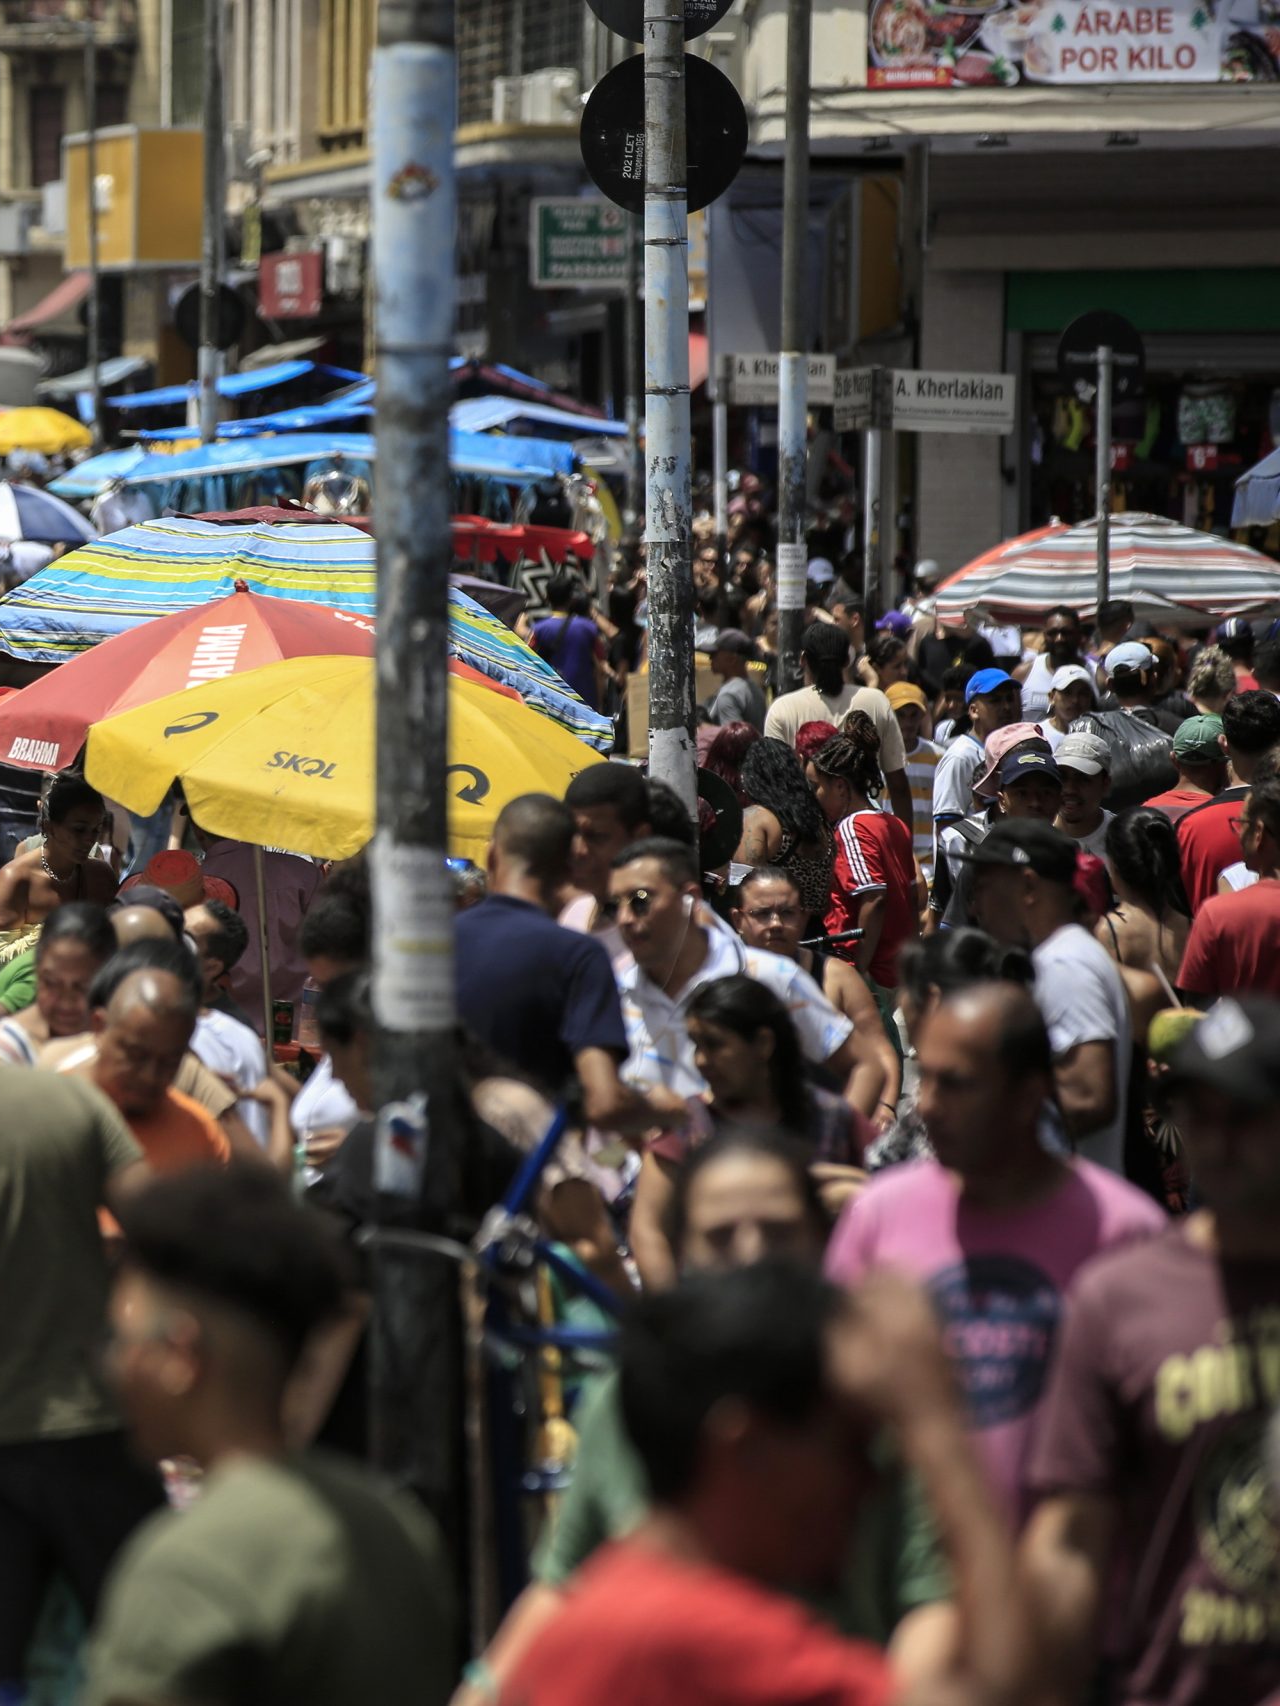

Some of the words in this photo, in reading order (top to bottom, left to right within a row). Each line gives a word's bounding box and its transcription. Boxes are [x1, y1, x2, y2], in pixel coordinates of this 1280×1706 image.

[1075, 6, 1174, 36] ÁRABE
[1060, 47, 1118, 72] POR
[1128, 44, 1197, 71] KILO
[738, 360, 750, 376] A.
[753, 359, 827, 377] Kheian
[896, 378, 911, 397] A.
[917, 377, 1004, 401] Kherlakian
[185, 623, 248, 689] AHMA
[7, 736, 60, 767] BRAHMA
[266, 751, 338, 779] SKOL
